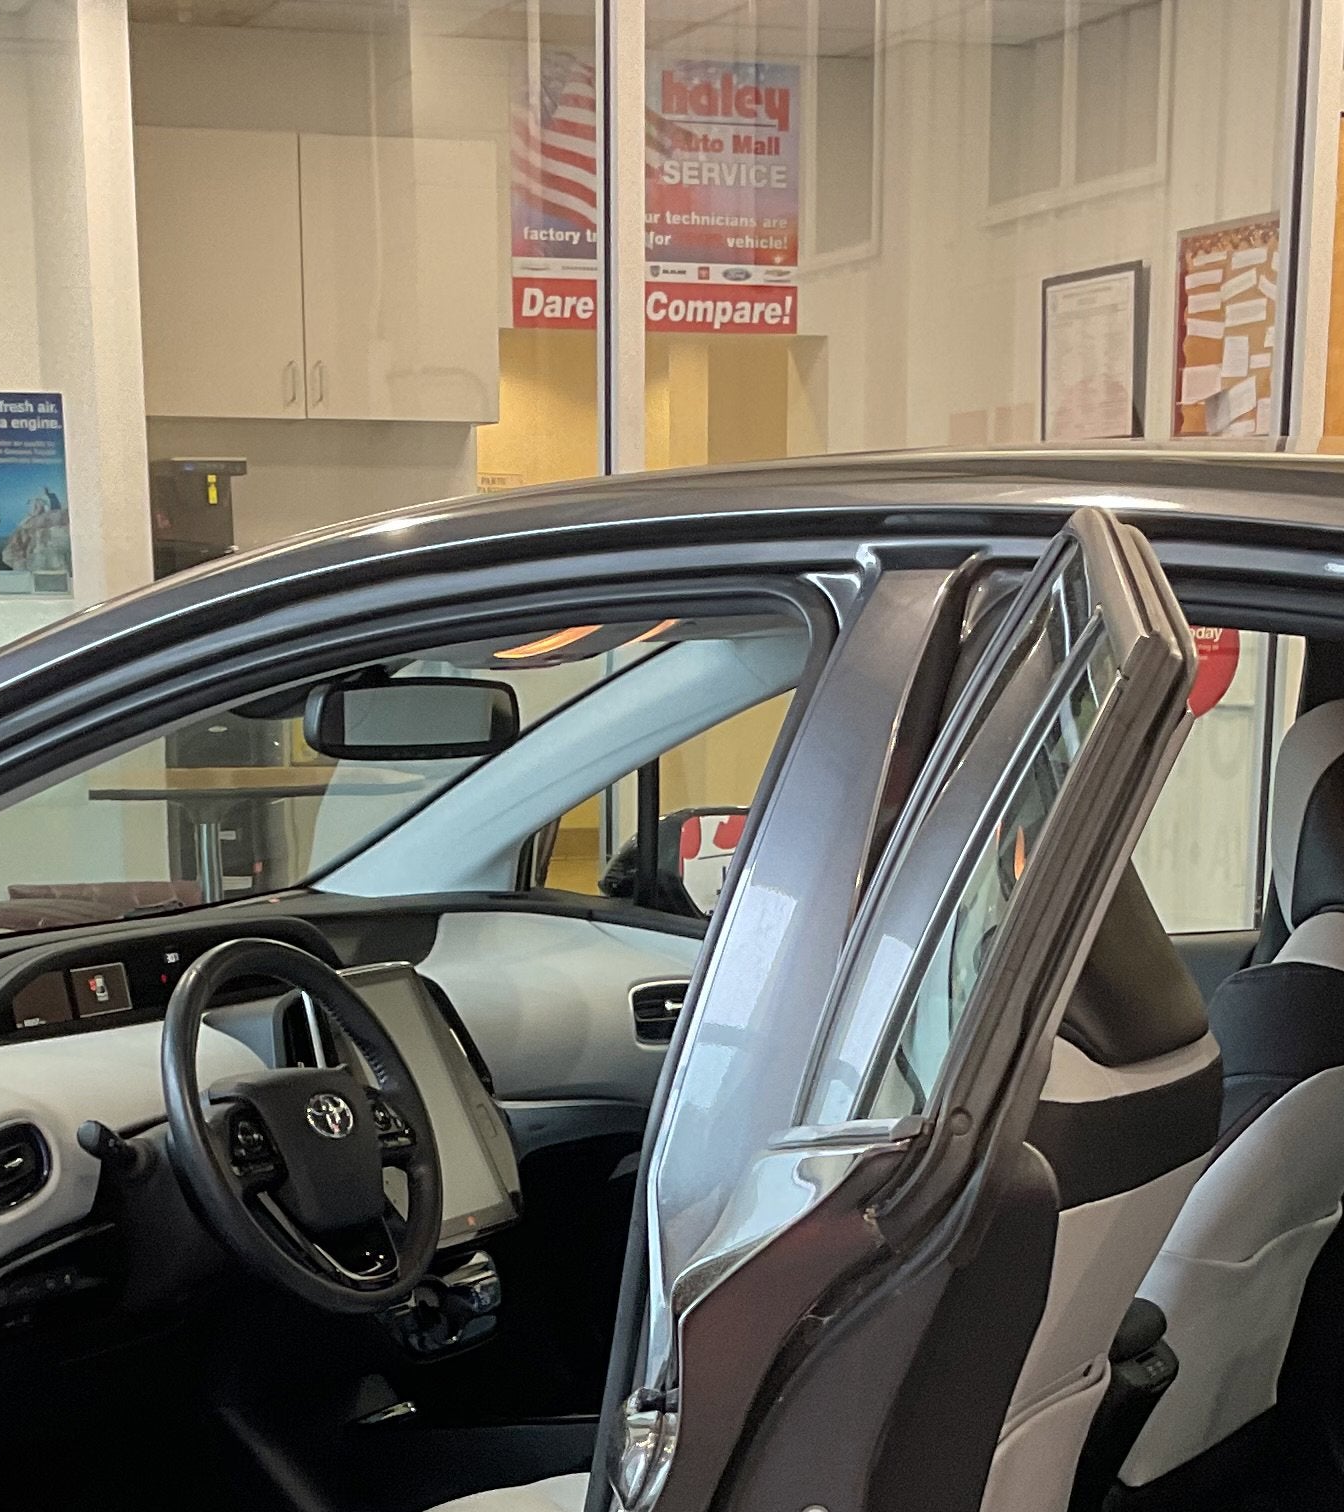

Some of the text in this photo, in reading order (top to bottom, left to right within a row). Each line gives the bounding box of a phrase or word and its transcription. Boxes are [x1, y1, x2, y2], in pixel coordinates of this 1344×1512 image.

[661, 69, 790, 132] haley
[732, 134, 780, 156] Mall
[663, 161, 788, 188] SERVICE
[645, 210, 788, 229] ur technicians are
[523, 226, 580, 245] factory
[726, 234, 789, 250] vehicle!
[522, 287, 792, 329] Dare Compare!
[0, 400, 34, 414] fresh
[37, 402, 58, 414] air.
[11, 417, 63, 432] engine.
[1189, 627, 1223, 643] oday
